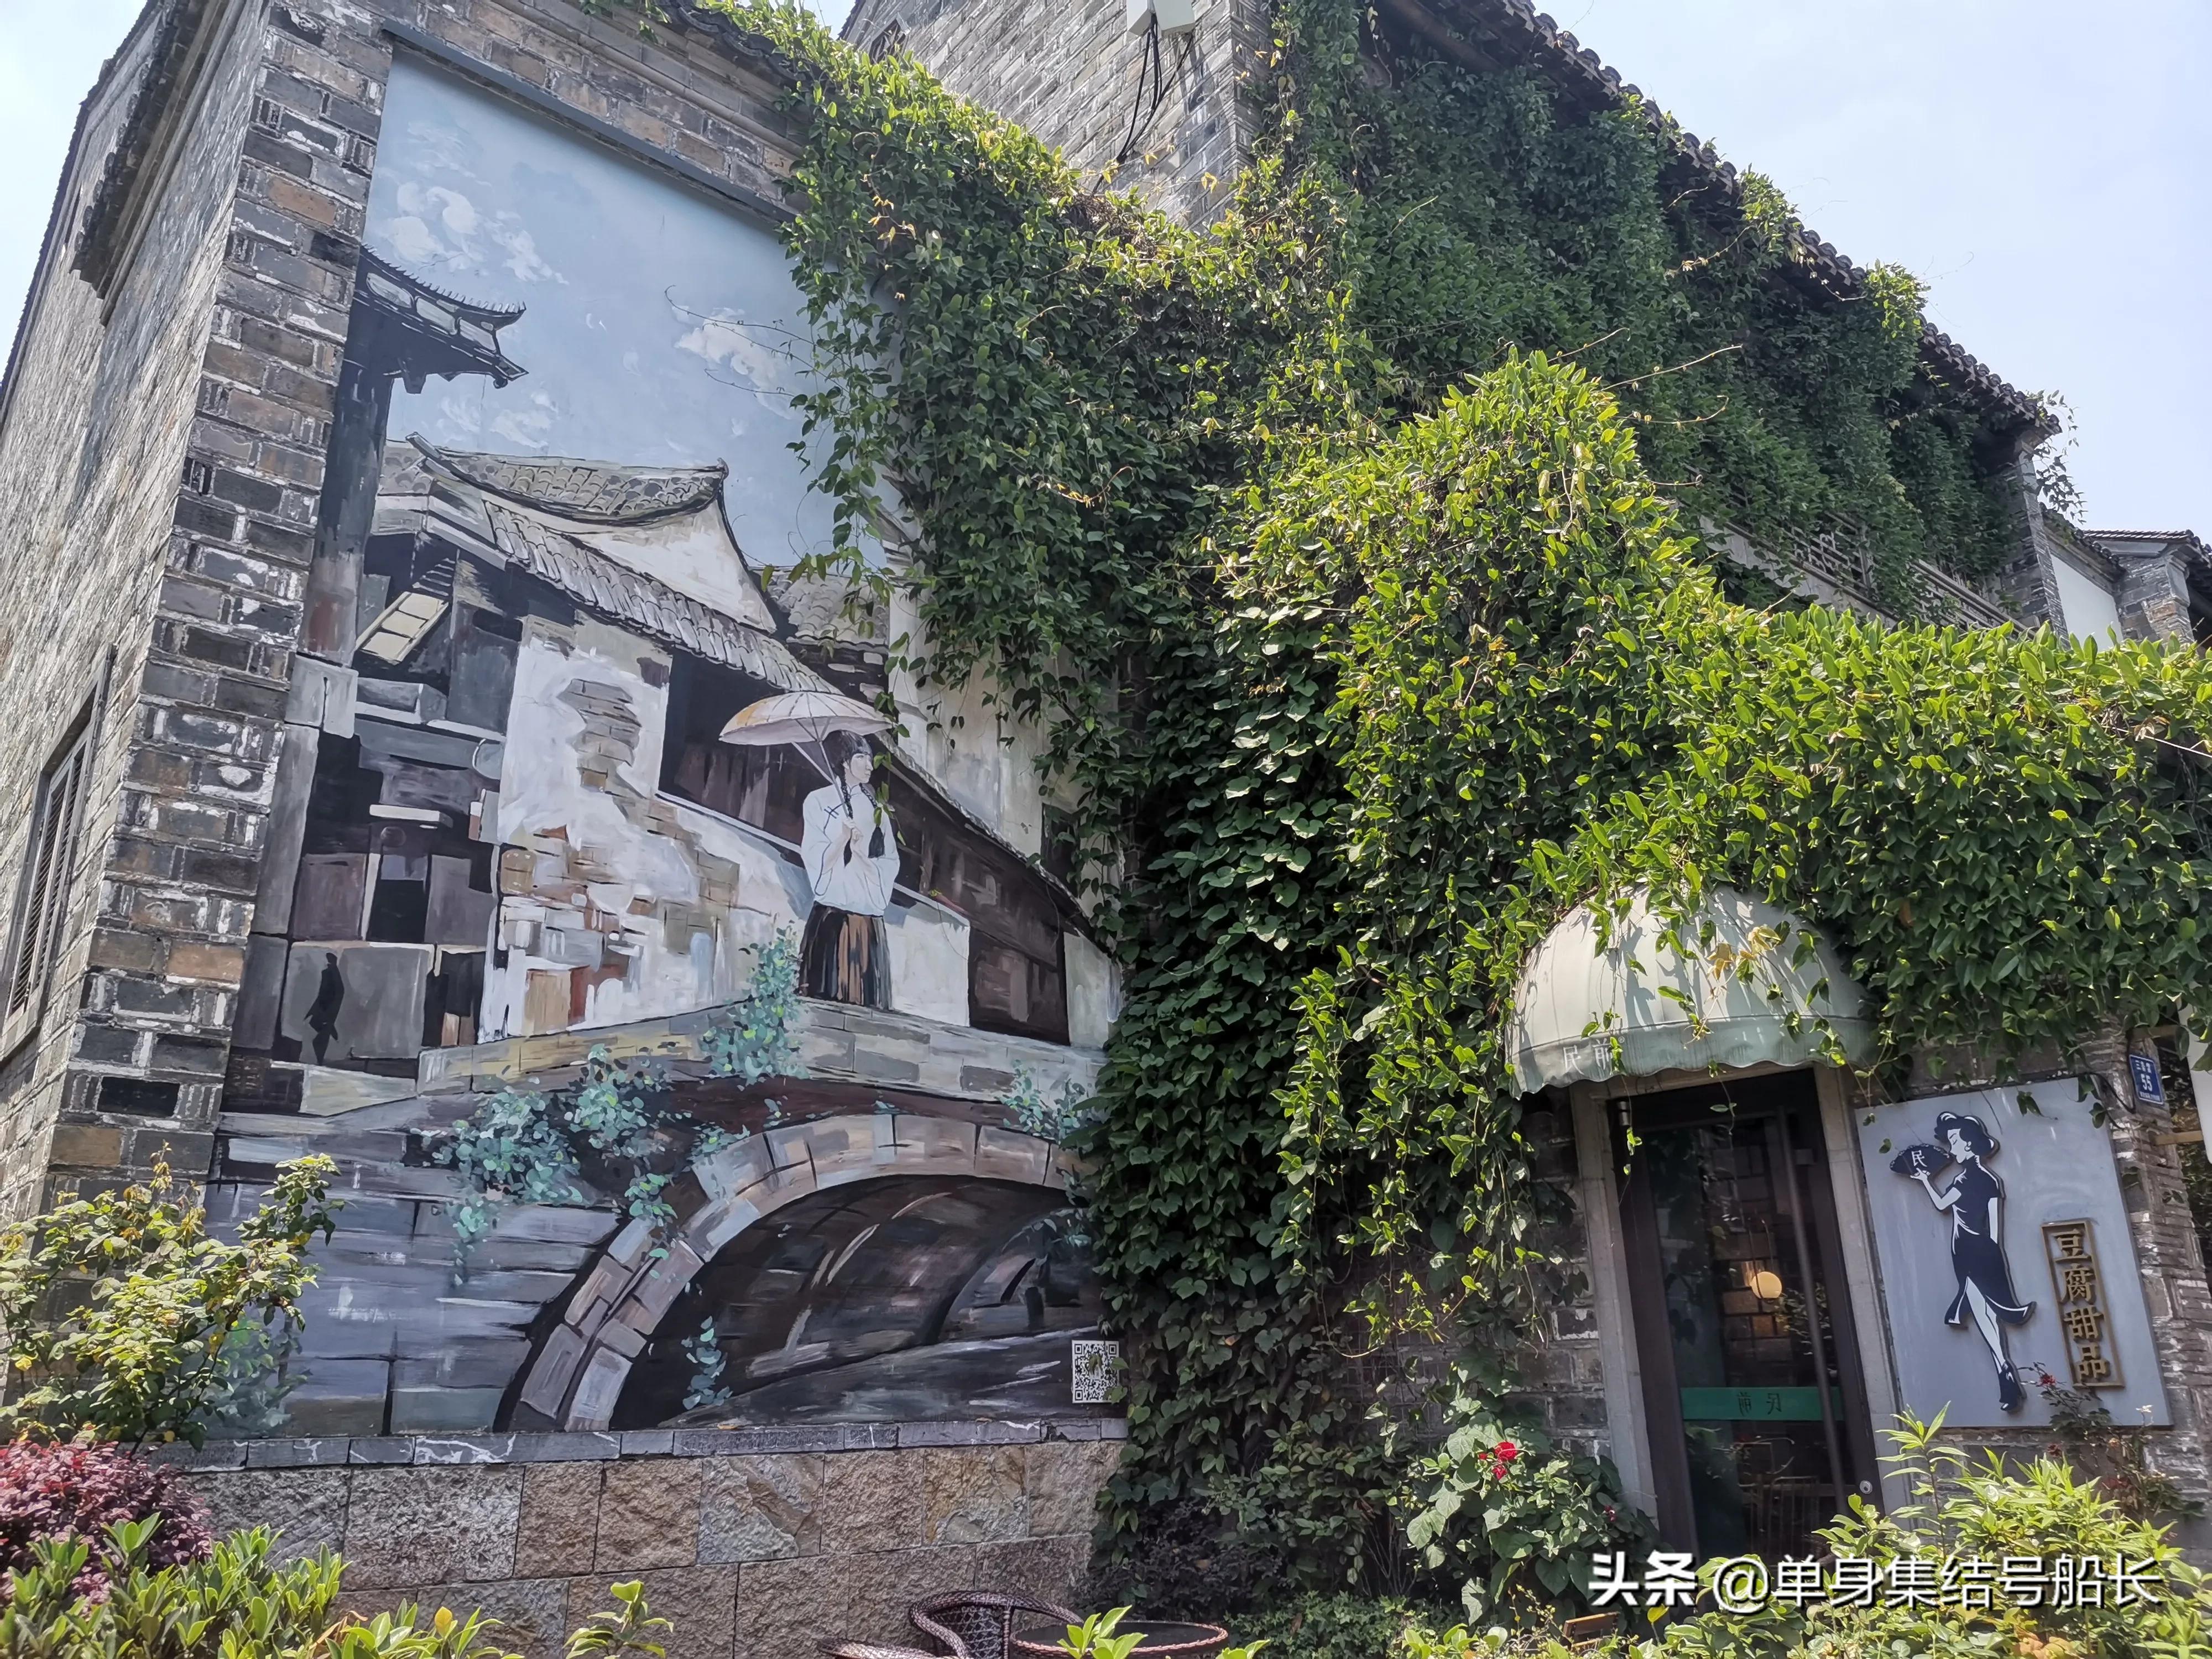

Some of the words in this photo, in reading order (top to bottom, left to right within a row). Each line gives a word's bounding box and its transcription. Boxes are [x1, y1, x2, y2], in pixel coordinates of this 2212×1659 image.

[2140, 1073, 2153, 1092] 55
[1911, 1150, 1928, 1167] 民
[2052, 1228, 2108, 1381] 豆腐甜品
